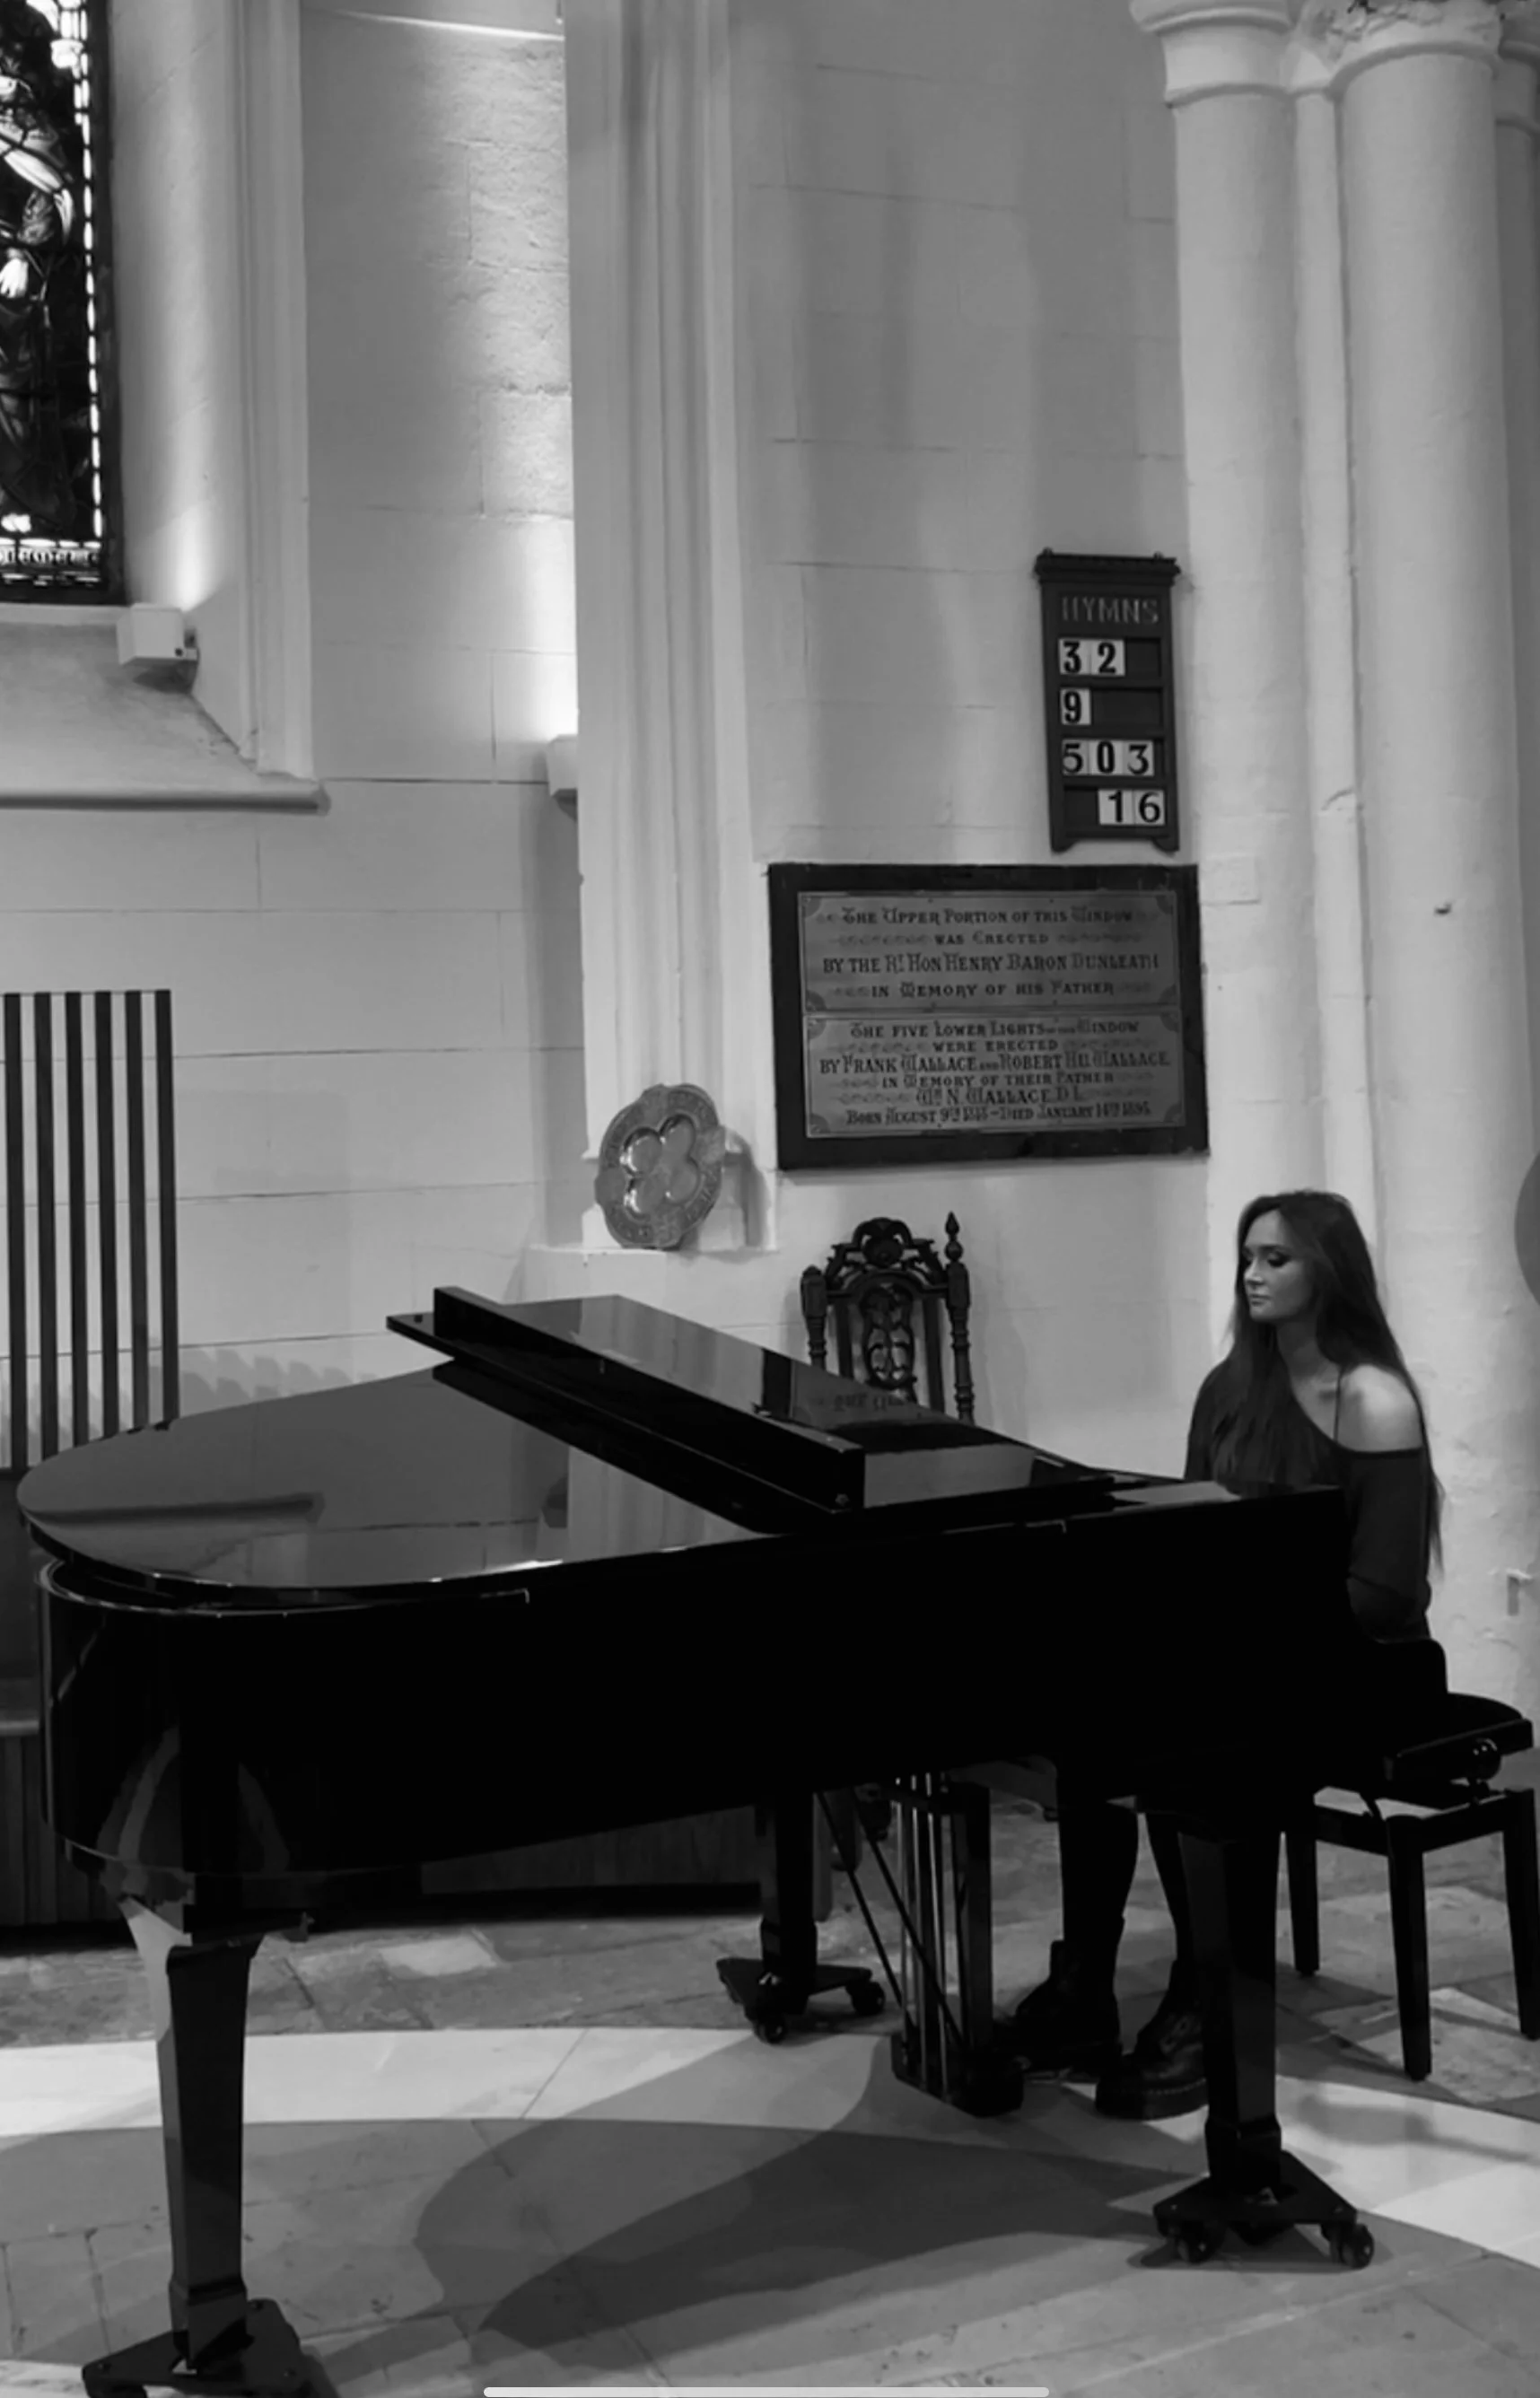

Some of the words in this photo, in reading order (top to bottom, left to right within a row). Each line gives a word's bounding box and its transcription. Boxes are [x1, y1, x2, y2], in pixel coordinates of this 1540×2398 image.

[1062, 596, 1159, 625] HYMNS
[1063, 641, 1116, 674] 32
[1064, 691, 1081, 723] 9
[1063, 740, 1149, 775] 503
[1108, 789, 1160, 823] 16
[823, 958, 844, 974] BY
[848, 958, 880, 973] THE
[871, 985, 889, 998] IN
